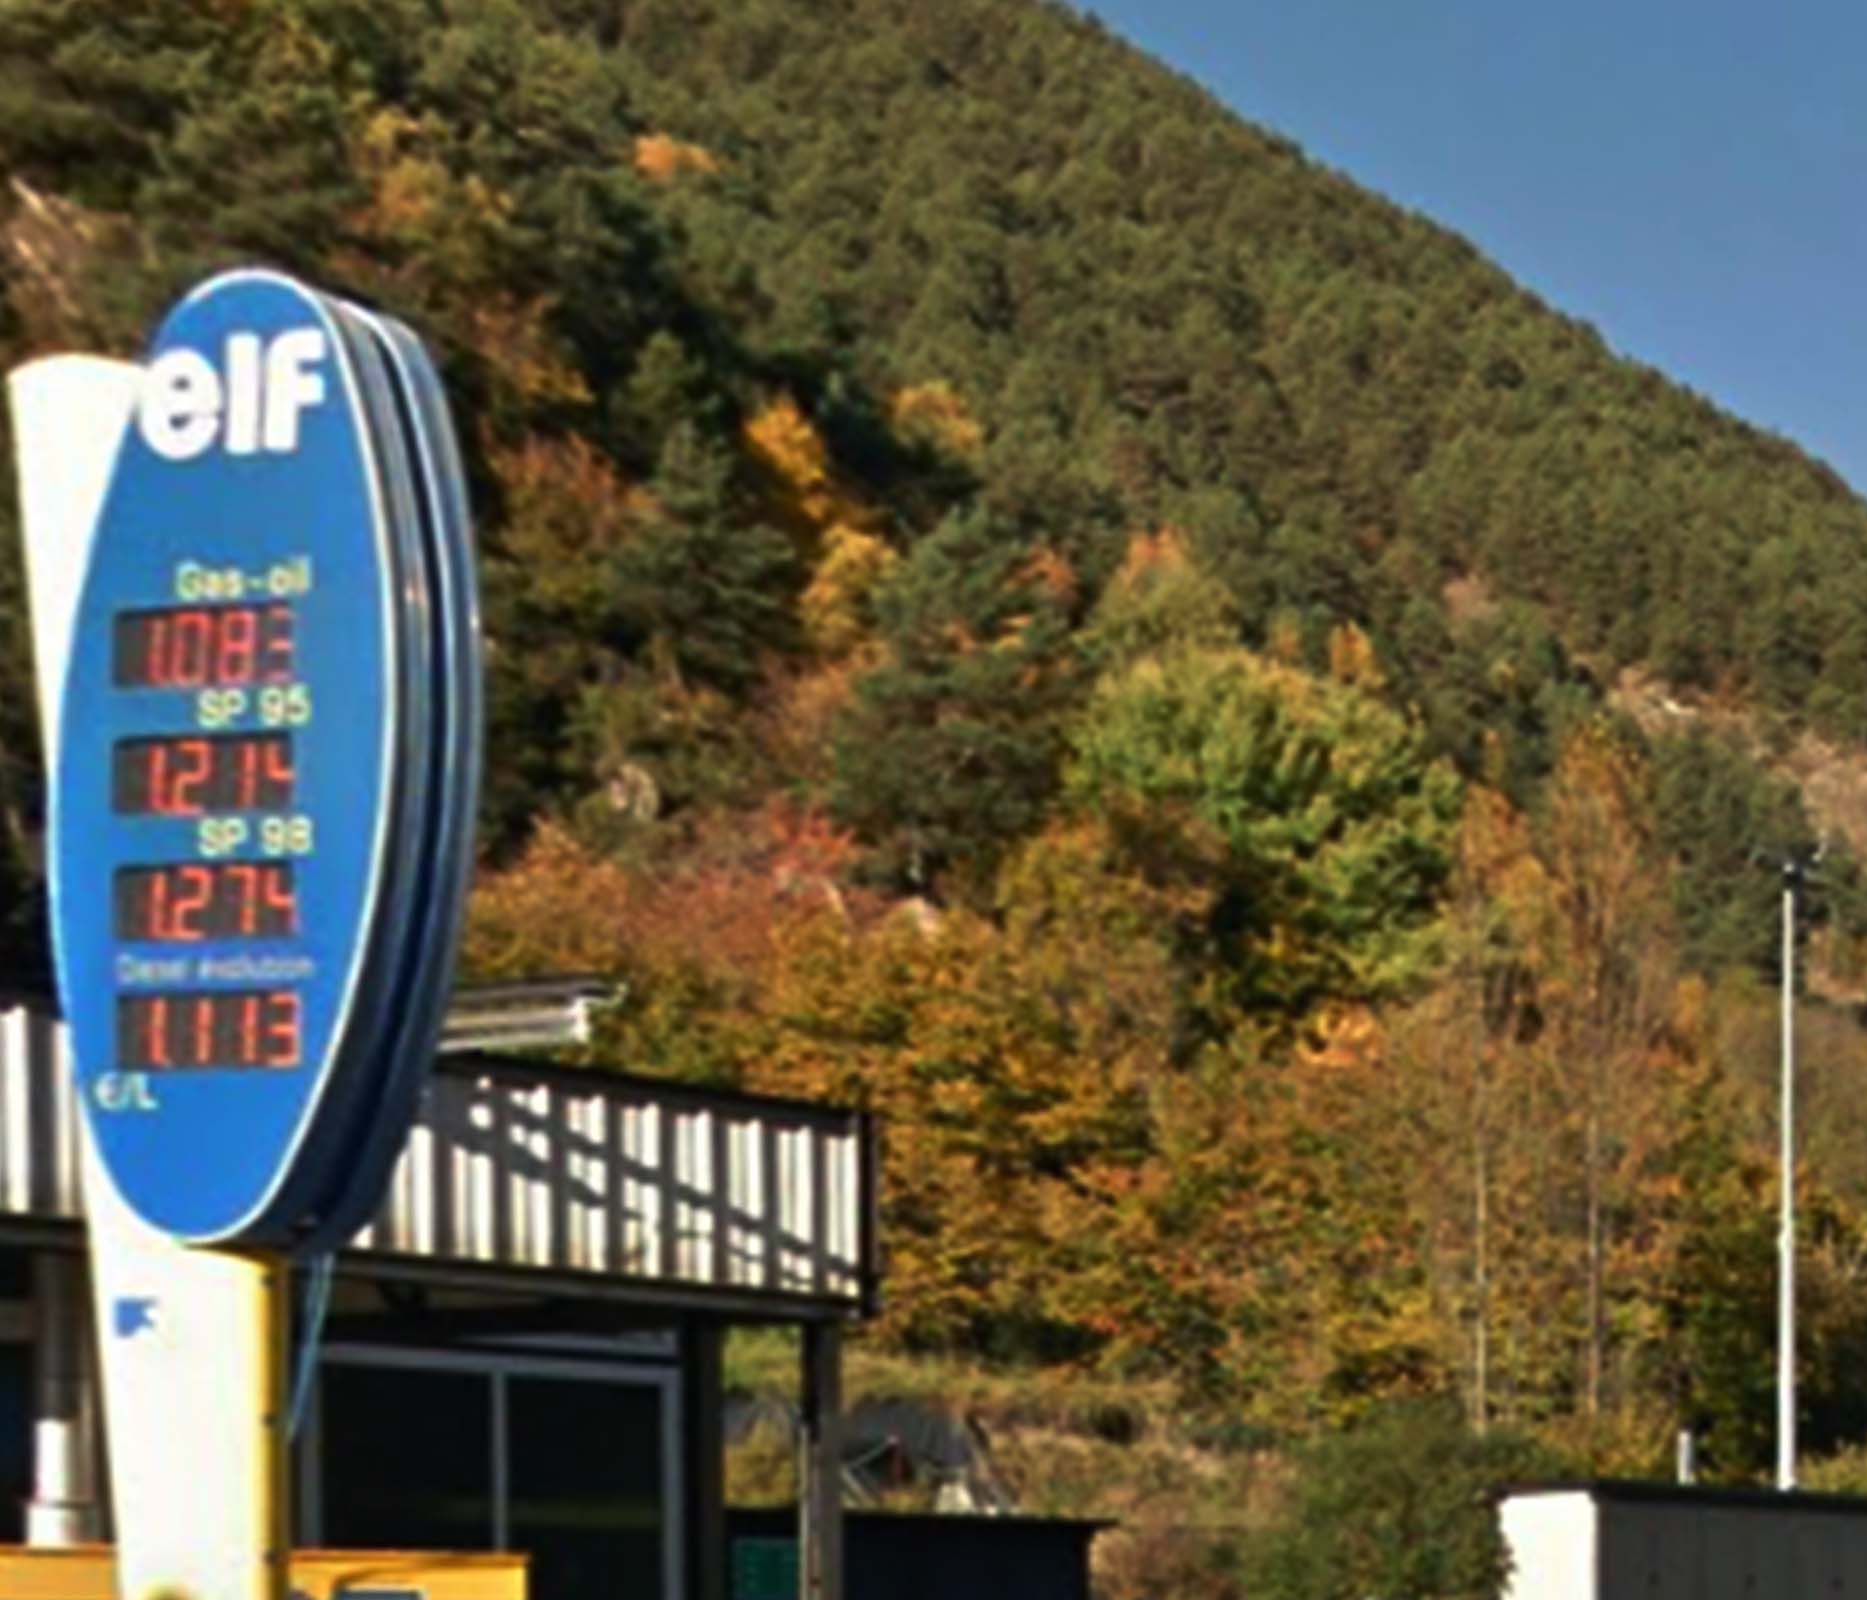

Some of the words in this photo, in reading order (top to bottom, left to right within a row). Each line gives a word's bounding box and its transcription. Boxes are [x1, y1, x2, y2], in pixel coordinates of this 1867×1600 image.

[141, 327, 326, 461] elf
[175, 556, 313, 601] Gas-oil
[197, 686, 247, 728] SP
[259, 682, 312, 727] 95
[197, 816, 248, 858] SP
[259, 813, 314, 856] 98
